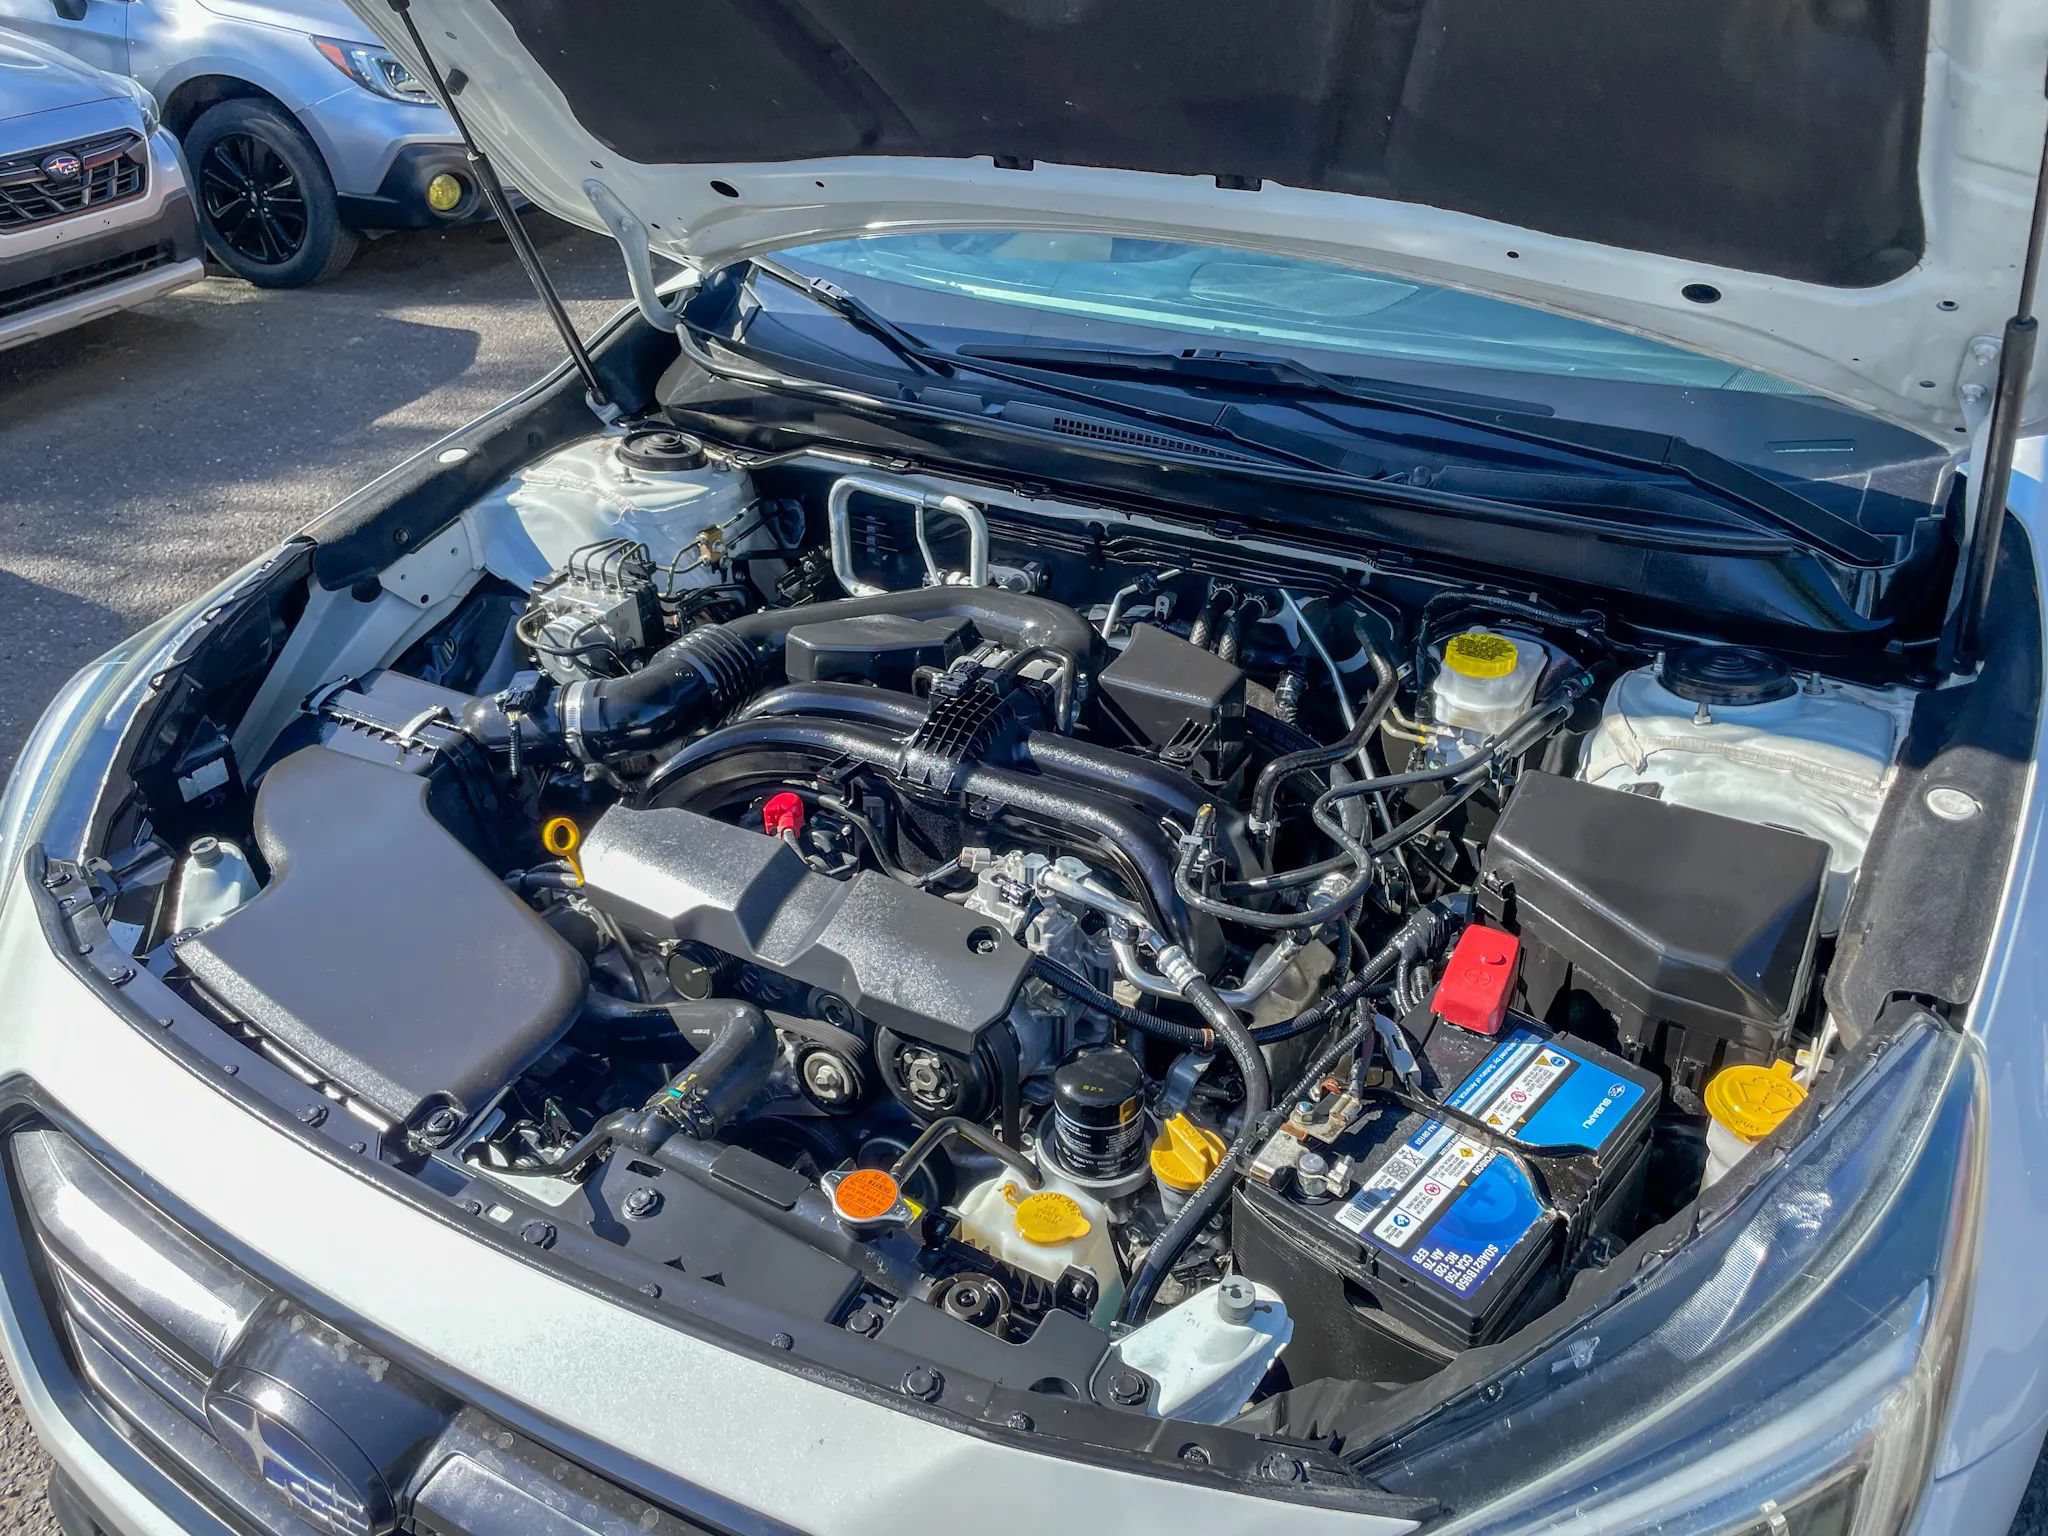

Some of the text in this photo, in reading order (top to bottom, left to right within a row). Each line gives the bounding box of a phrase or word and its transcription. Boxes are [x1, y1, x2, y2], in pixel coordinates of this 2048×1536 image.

[1582, 1097, 1612, 1129] SUBARU
[1410, 1247, 1429, 1264] EFB
[1421, 1247, 1444, 1270] Ah 76
[1432, 1250, 1458, 1277] RC 120
[1443, 1252, 1473, 1284] CCA 750
[1455, 1244, 1498, 1291] SOA821B950
